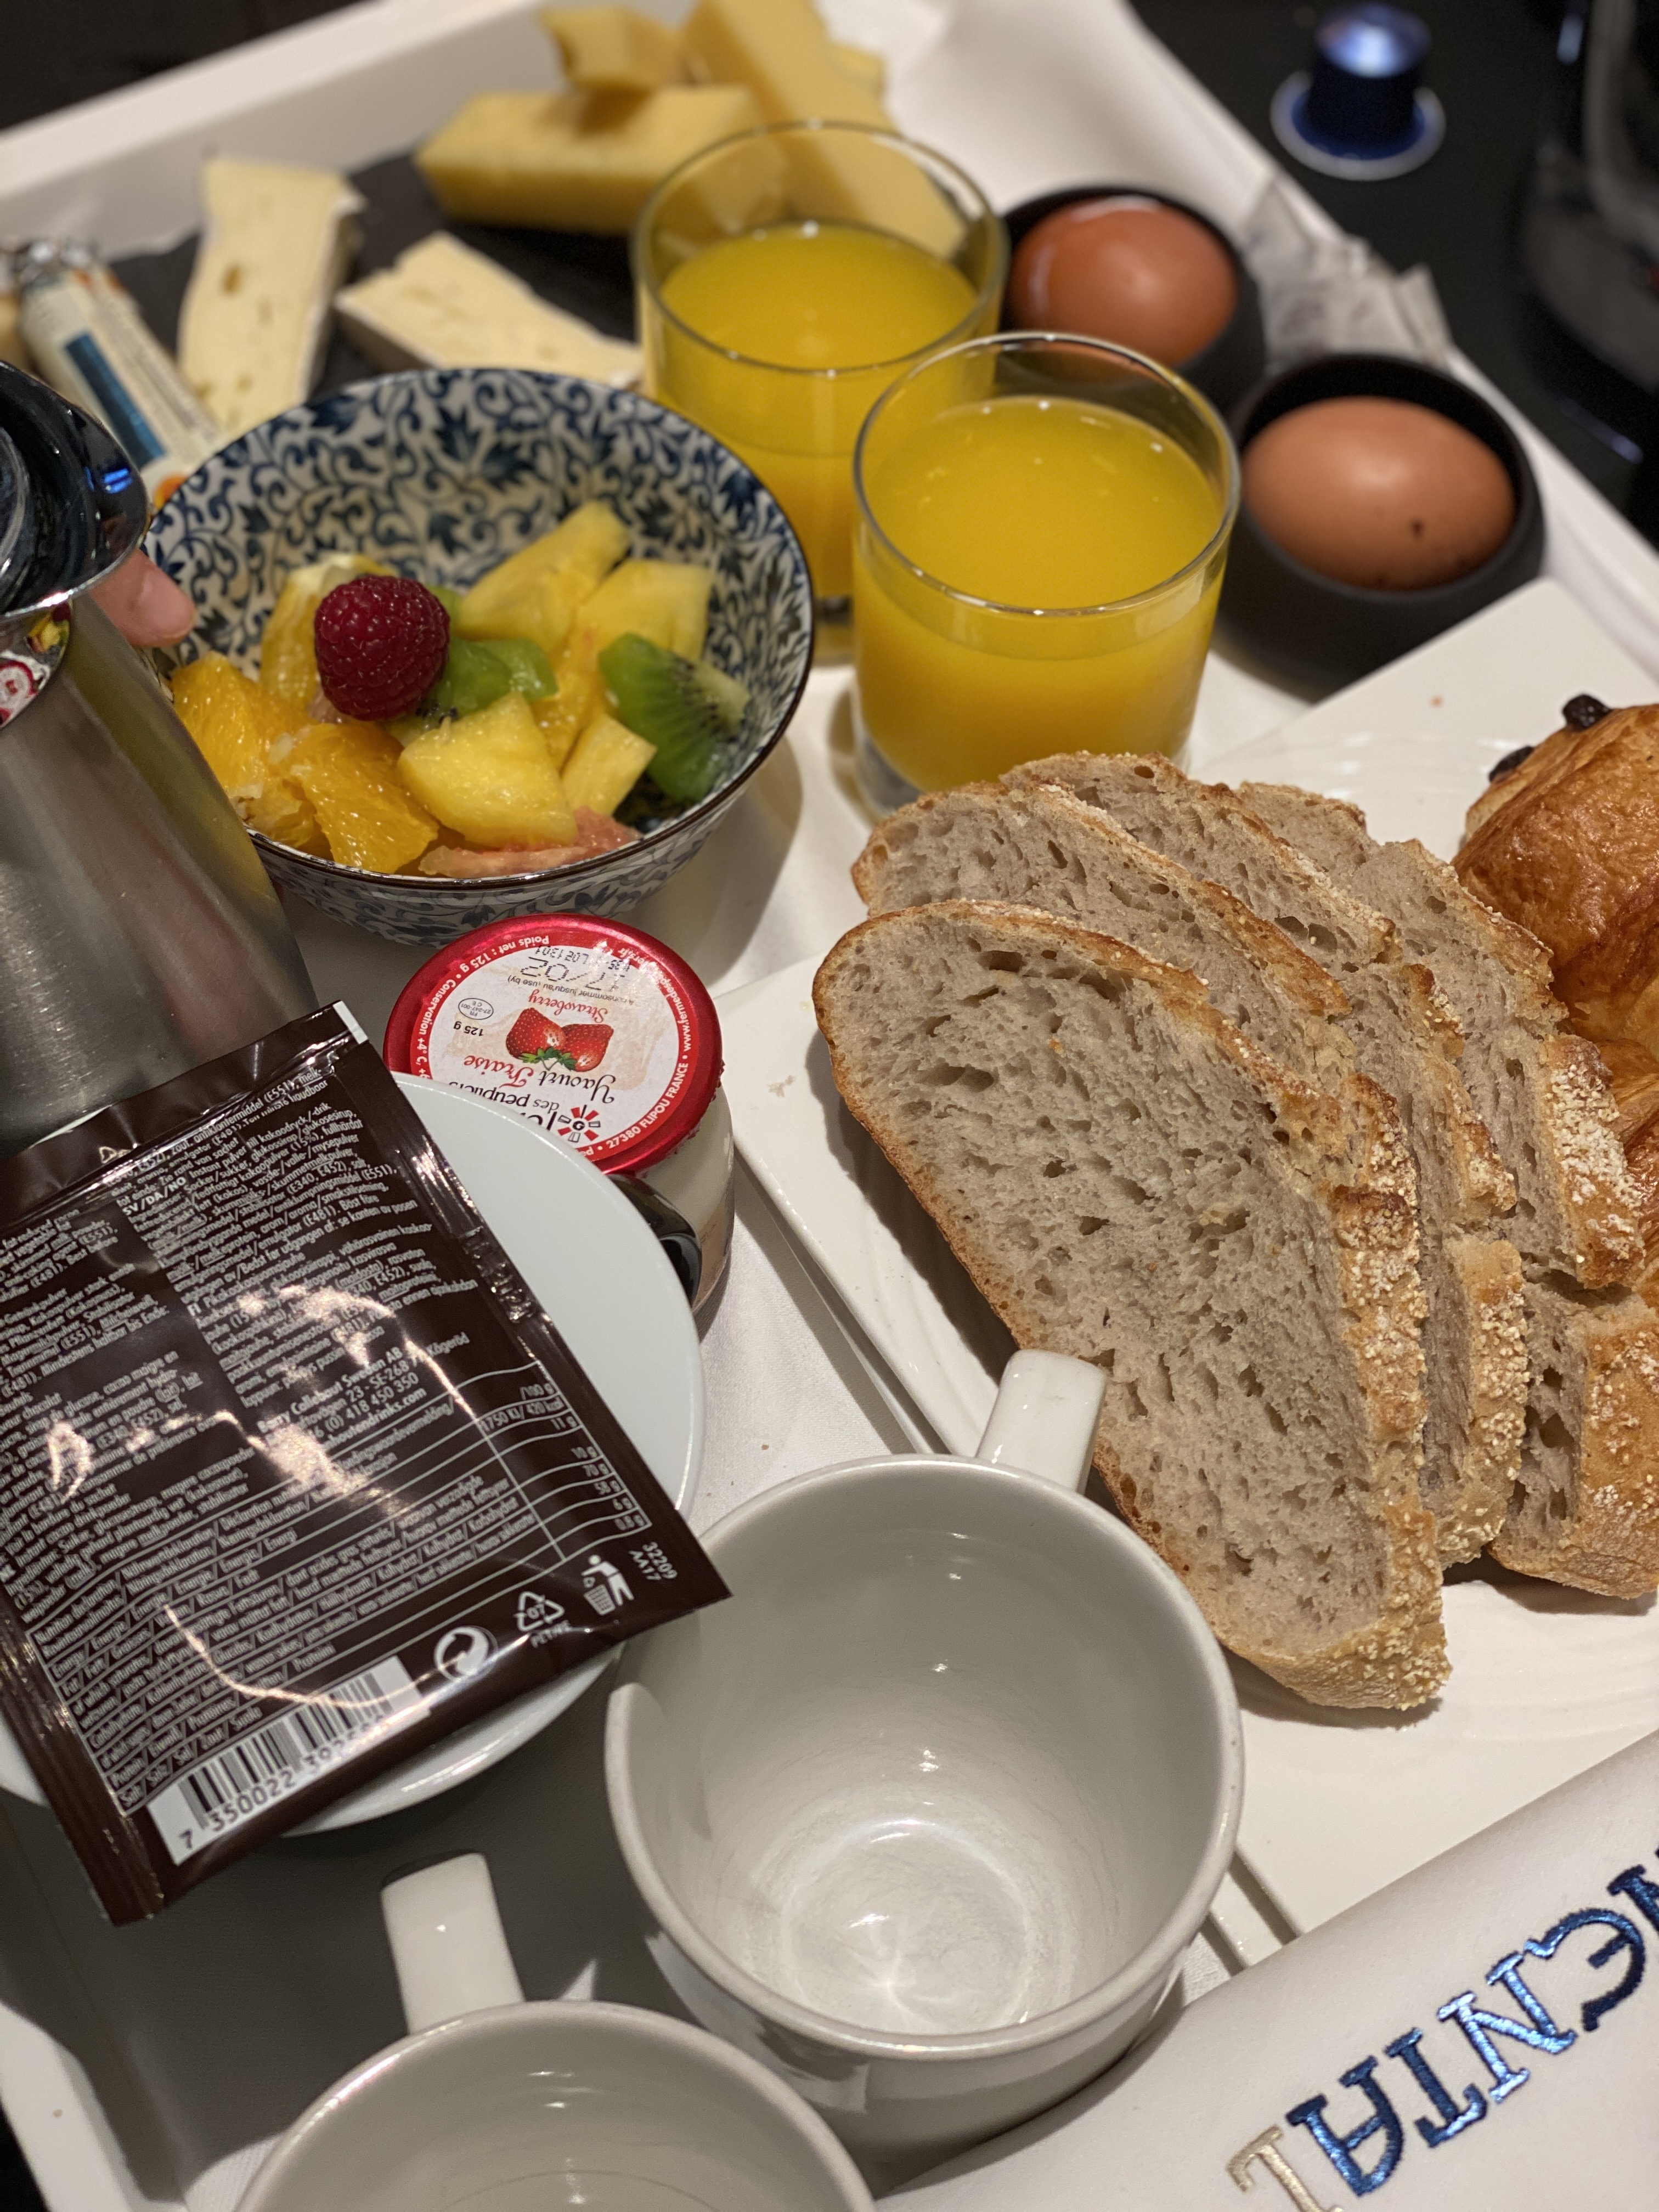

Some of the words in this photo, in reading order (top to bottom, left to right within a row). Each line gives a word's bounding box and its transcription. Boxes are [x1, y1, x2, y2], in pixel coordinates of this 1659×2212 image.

[499, 941, 516, 952] net
[520, 935, 550, 947] Poids
[459, 962, 470, 973] g
[470, 953, 492, 968] 125
[507, 974, 521, 985] by)
[419, 979, 456, 1035] Conservation
[528, 989, 608, 1023] Strawberry
[454, 1020, 461, 1030] g
[464, 1024, 484, 1037] 125
[464, 1055, 534, 1088] Fraise
[538, 1070, 617, 1103] Yaourt
[533, 1099, 560, 1114] des
[606, 1126, 641, 1149] 27380
[640, 1098, 670, 1128] FLIPOU
[665, 1063, 689, 1099] FRANCE
[122, 1176, 188, 1217] SV/DA/NO
[189, 1158, 221, 1181] Instant
[220, 1146, 250, 1170] pulver
[246, 1137, 258, 1148] till
[258, 1099, 332, 1145] kakaodryck/-drik
[173, 1160, 194, 1176] rand
[195, 1154, 211, 1167] van
[210, 1137, 240, 1159] sachet
[238, 1146, 290, 1182] kakaopulver
[290, 1130, 324, 1153] (15%),
[360, 1162, 397, 1181] (E551),
[183, 1155, 251, 1197] Socker/sukker,
[285, 1171, 319, 1195] (E340,
[317, 1160, 351, 1177] E452),
[195, 1198, 212, 1211] fett
[212, 1178, 252, 1206] (kokos),
[302, 1201, 341, 1228] (E481).
[339, 1194, 360, 1212] Bäst
[337, 1215, 349, 1227] se
[348, 1204, 381, 1222] kanten
[187, 1302, 201, 1316] FI
[289, 1380, 343, 1415] Callebaut
[341, 1356, 386, 1386] Sweden
[385, 1346, 403, 1363] AB
[345, 1385, 365, 1403] 23
[368, 1359, 410, 1389] SE-268
[323, 1413, 345, 1433] (0)
[343, 1399, 370, 1420] 418
[369, 1386, 395, 1406] 450
[393, 1371, 420, 1392] 350
[479, 1411, 509, 1432] 1750
[550, 1417, 566, 1430] 11
[642, 1542, 678, 1579] 32209
[526, 1603, 545, 1619] 07
[178, 1829, 193, 1849] 7
[211, 1769, 297, 1833] 350022
